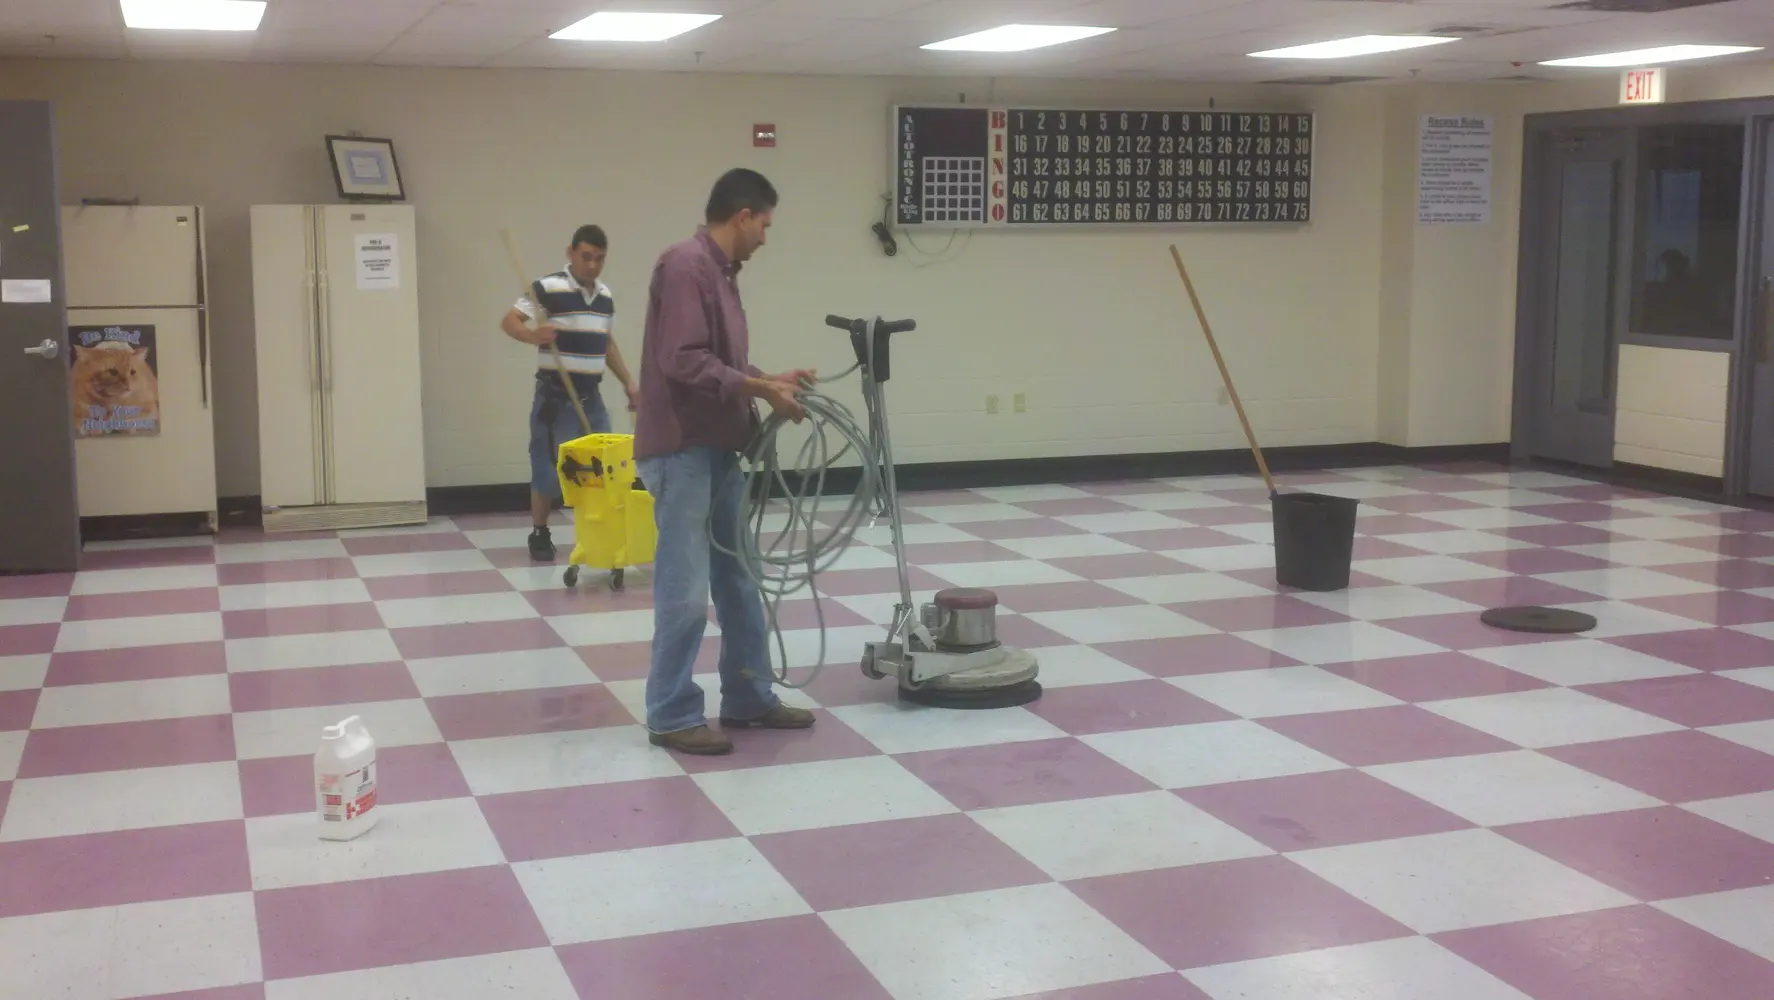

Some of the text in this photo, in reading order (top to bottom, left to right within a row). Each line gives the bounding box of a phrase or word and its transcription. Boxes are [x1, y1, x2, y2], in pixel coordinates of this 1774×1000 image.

[1626, 71, 1654, 100] EXIT
[1016, 112, 1309, 133] 1 2 3 4 5 6 7 8 9 10 11 12 13 14 15
[1013, 135, 1310, 156] 16 17 18 19 20 21 22 23 24 25 26 27 28 29 30
[991, 110, 1006, 221] BINGO
[1012, 158, 1309, 177] 31 32 33 34 35 36 37 38 39 40 41 42 43 44 45
[1011, 180, 1308, 199] 46 47 48 49 50 51 52 53 54 55 56 57 58 59 60
[1012, 203, 1308, 221] 61 62 63 64 65 66 67 68 69 70 71 72 73 74 75
